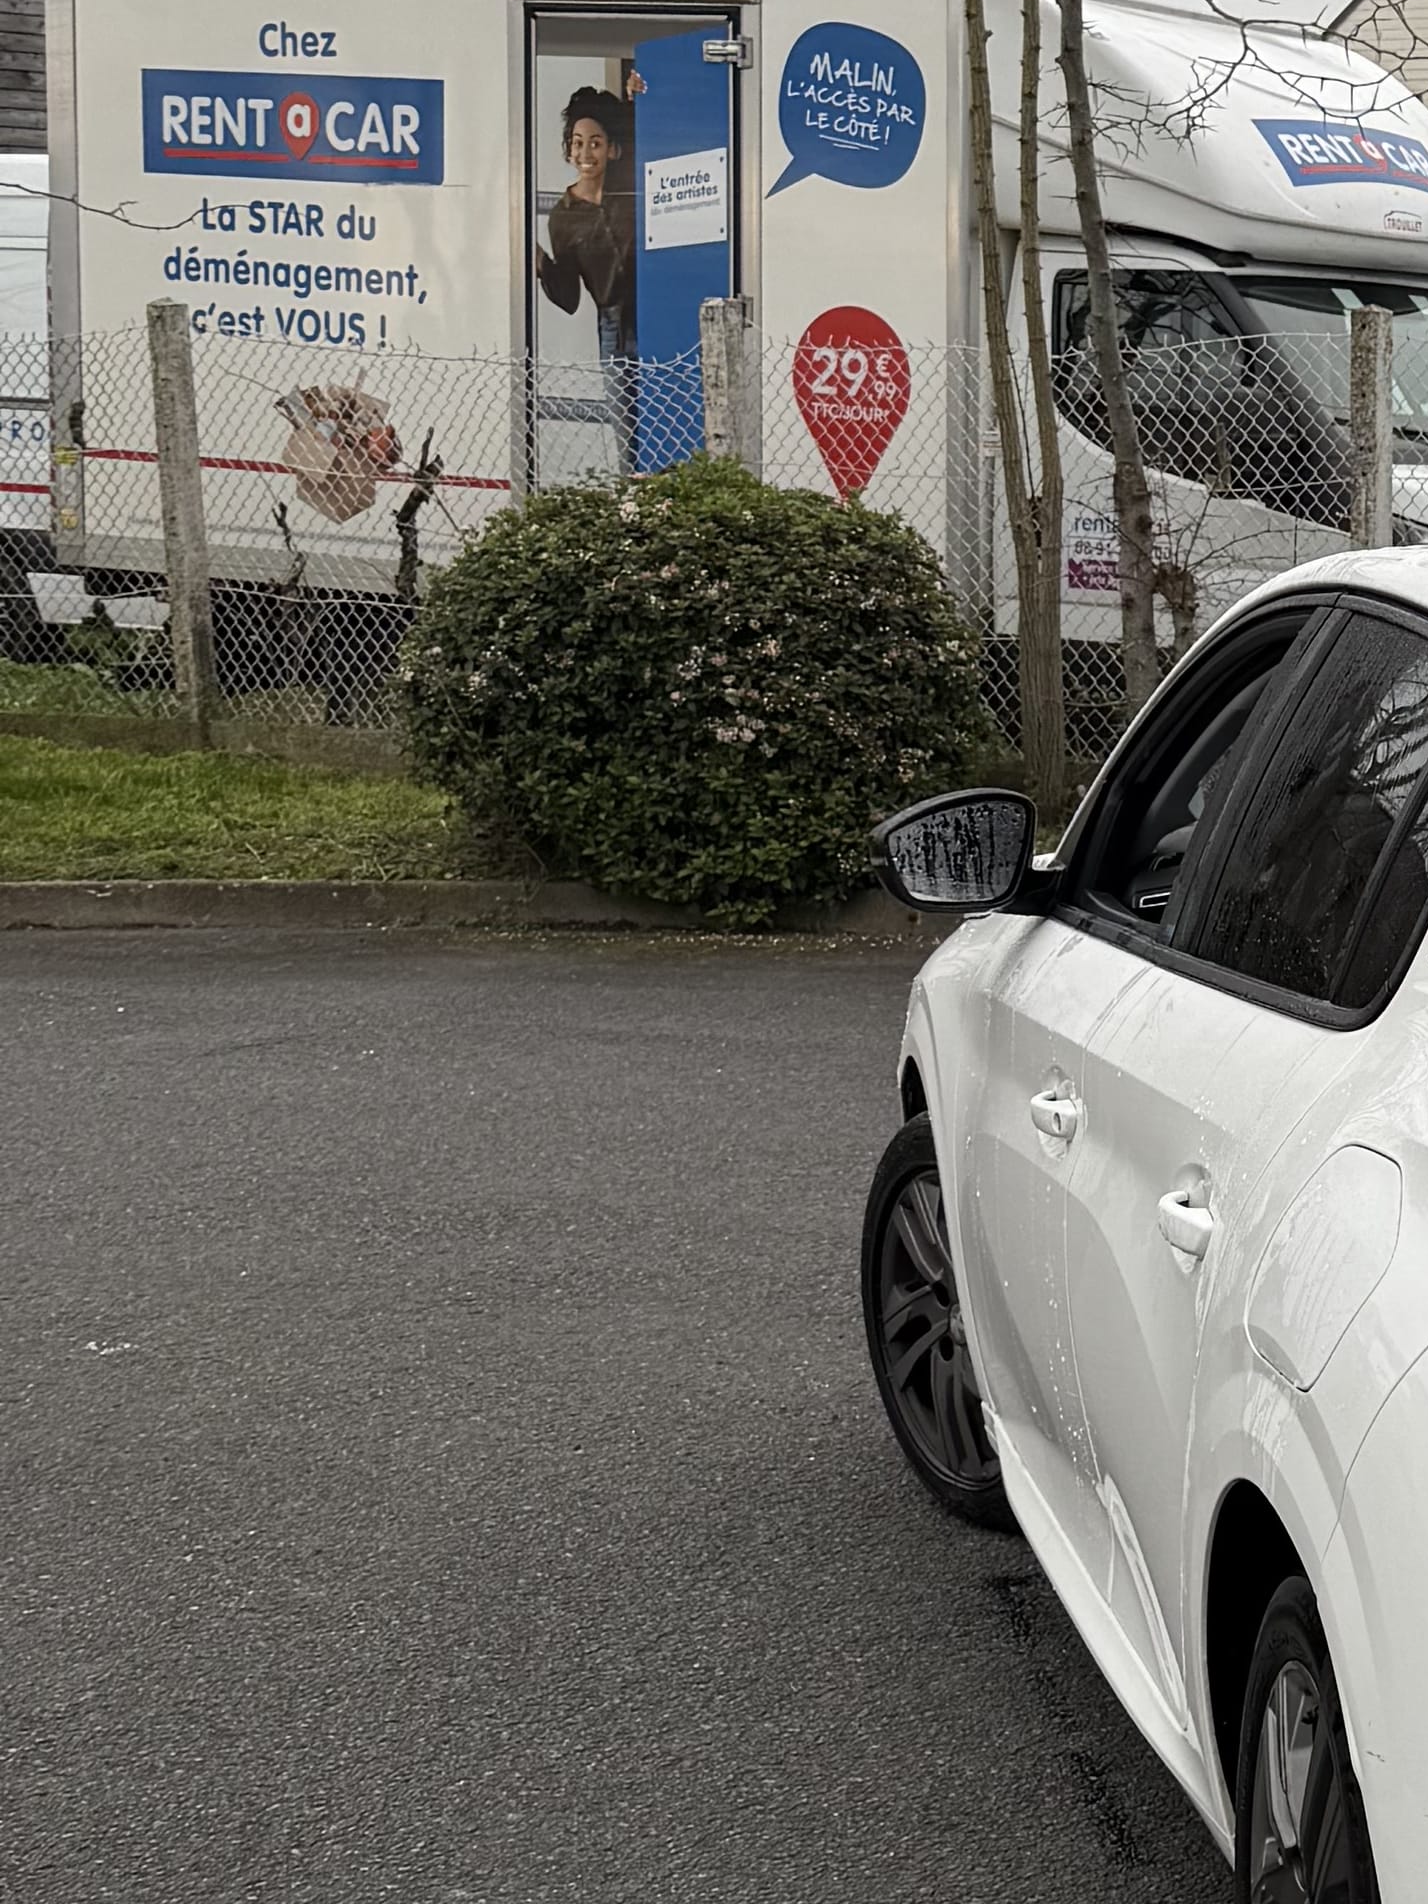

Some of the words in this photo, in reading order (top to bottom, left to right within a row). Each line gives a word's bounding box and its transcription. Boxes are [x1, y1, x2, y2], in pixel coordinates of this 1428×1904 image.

[259, 21, 337, 57] Chez
[810, 52, 897, 96] MALIN,
[787, 80, 871, 112] L'ACCÈS
[876, 102, 916, 125] PAR
[805, 110, 829, 130] LE
[162, 95, 274, 147] RENT
[286, 104, 310, 137] a
[325, 101, 420, 155] CAR
[1278, 133, 1363, 165] RENT
[676, 184, 718, 201] artistes
[202, 198, 236, 231] La
[249, 200, 324, 237] STAR
[336, 204, 376, 240] du
[163, 246, 427, 304] déménagement,
[191, 302, 264, 336] c'est
[275, 306, 366, 345] VOUS
[812, 347, 868, 396] 29
